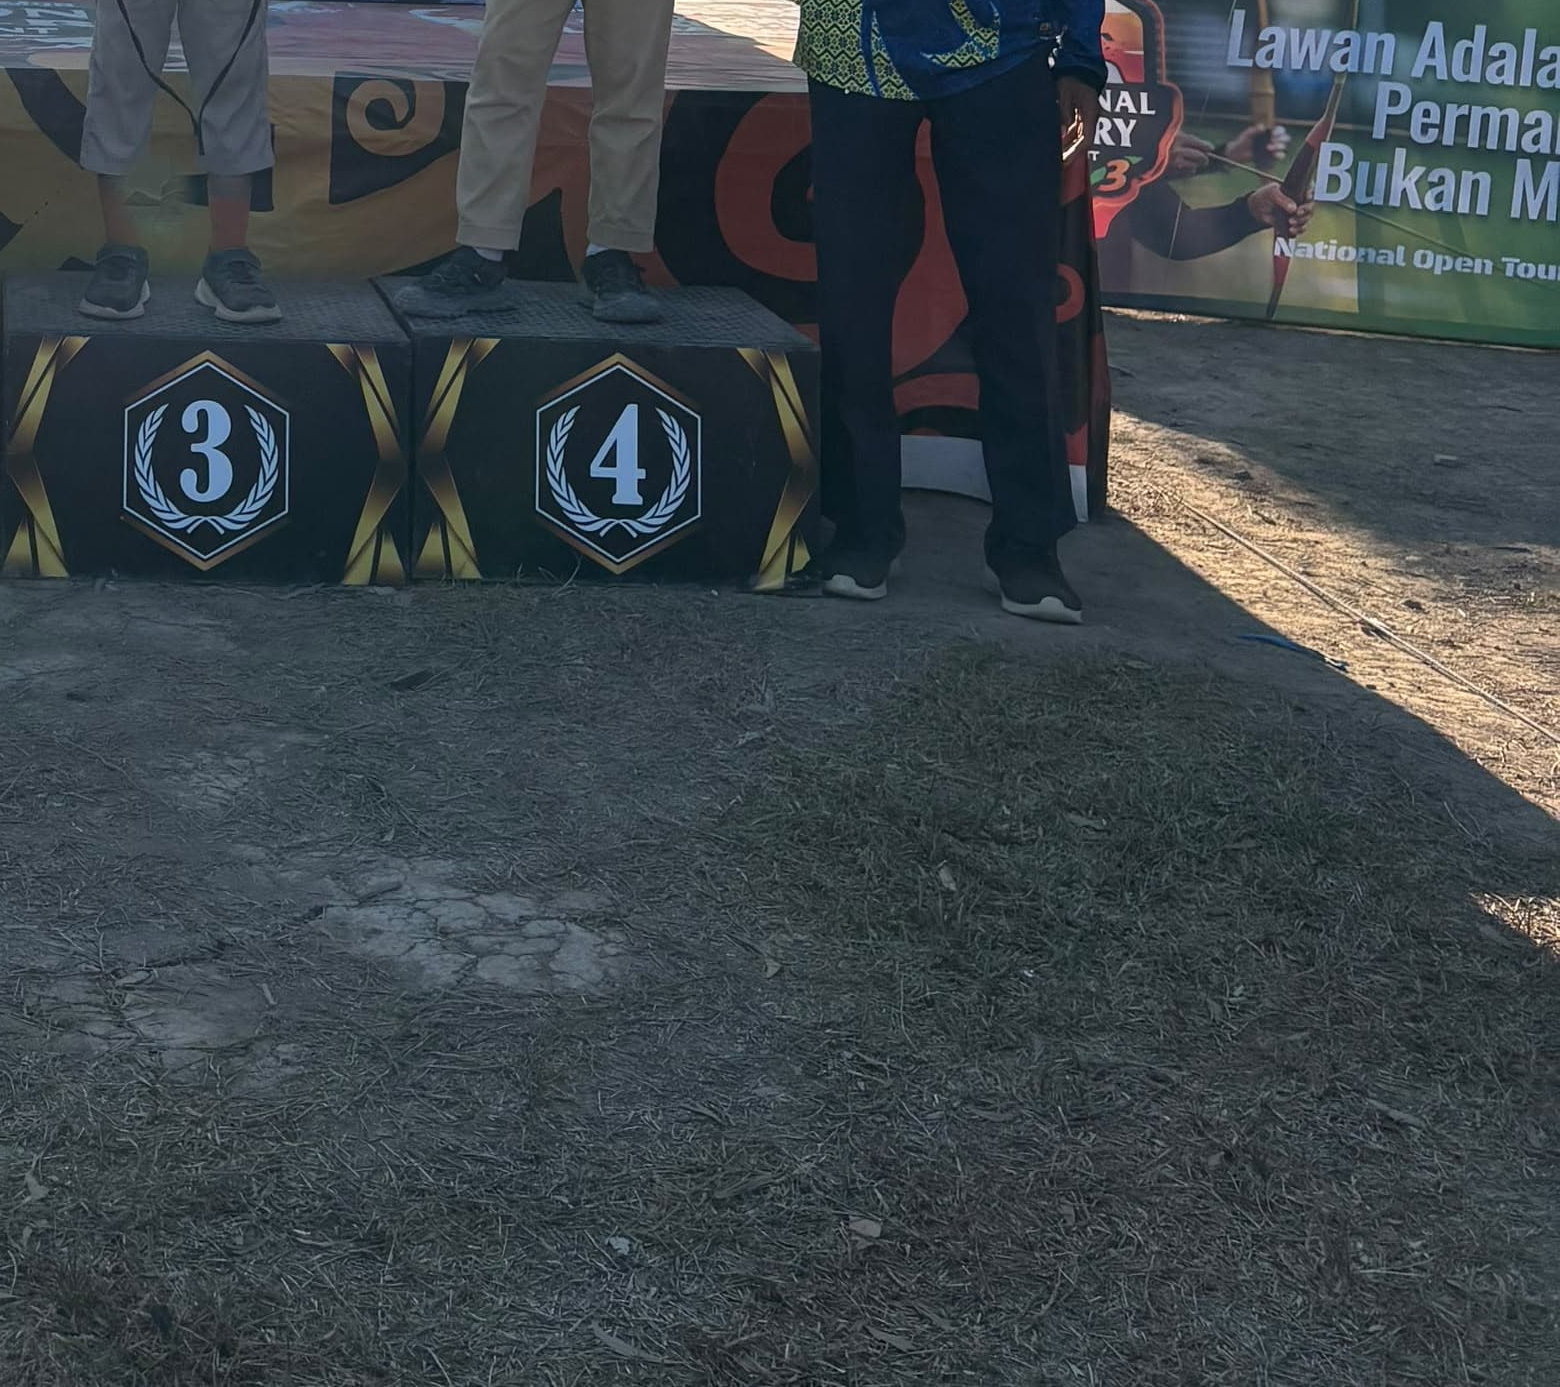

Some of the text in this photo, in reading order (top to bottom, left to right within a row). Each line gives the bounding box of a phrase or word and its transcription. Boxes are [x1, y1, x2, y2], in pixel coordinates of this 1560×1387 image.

[1226, 8, 1560, 90] Lawan Adala
[1371, 81, 1560, 156] Perma
[1313, 141, 1492, 217] Bukan
[1273, 236, 1560, 282] National Open Tou
[179, 399, 234, 503] 3
[589, 402, 646, 506] 4
